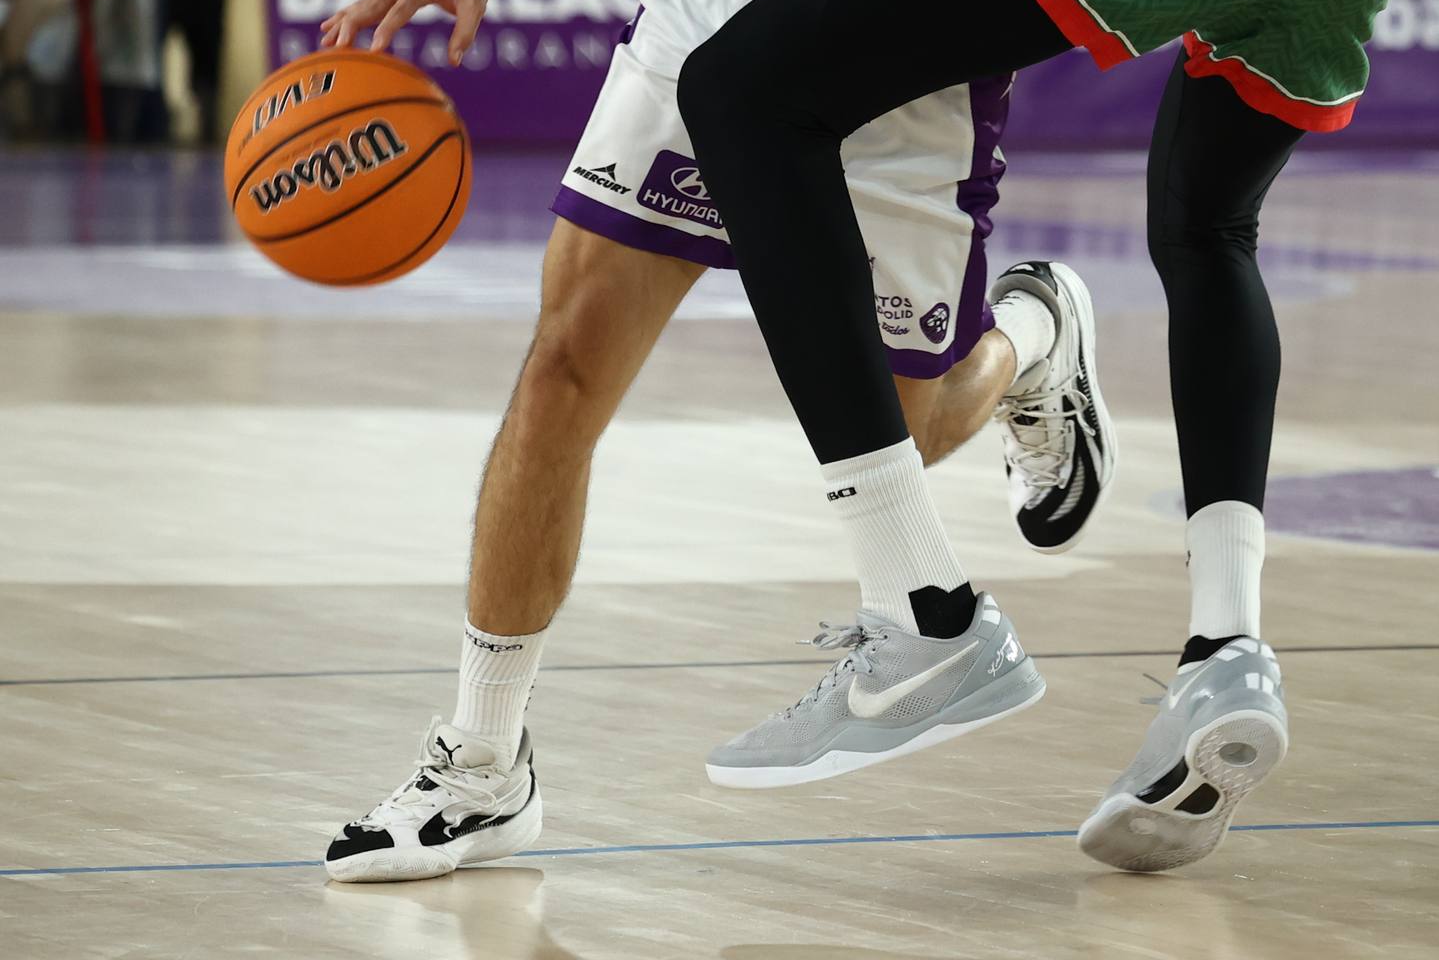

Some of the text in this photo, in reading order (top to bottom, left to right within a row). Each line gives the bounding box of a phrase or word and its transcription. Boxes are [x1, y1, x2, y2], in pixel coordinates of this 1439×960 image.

[249, 117, 408, 216] Wilson
[573, 166, 632, 195] MERCURY
[877, 296, 912, 308] TOS
